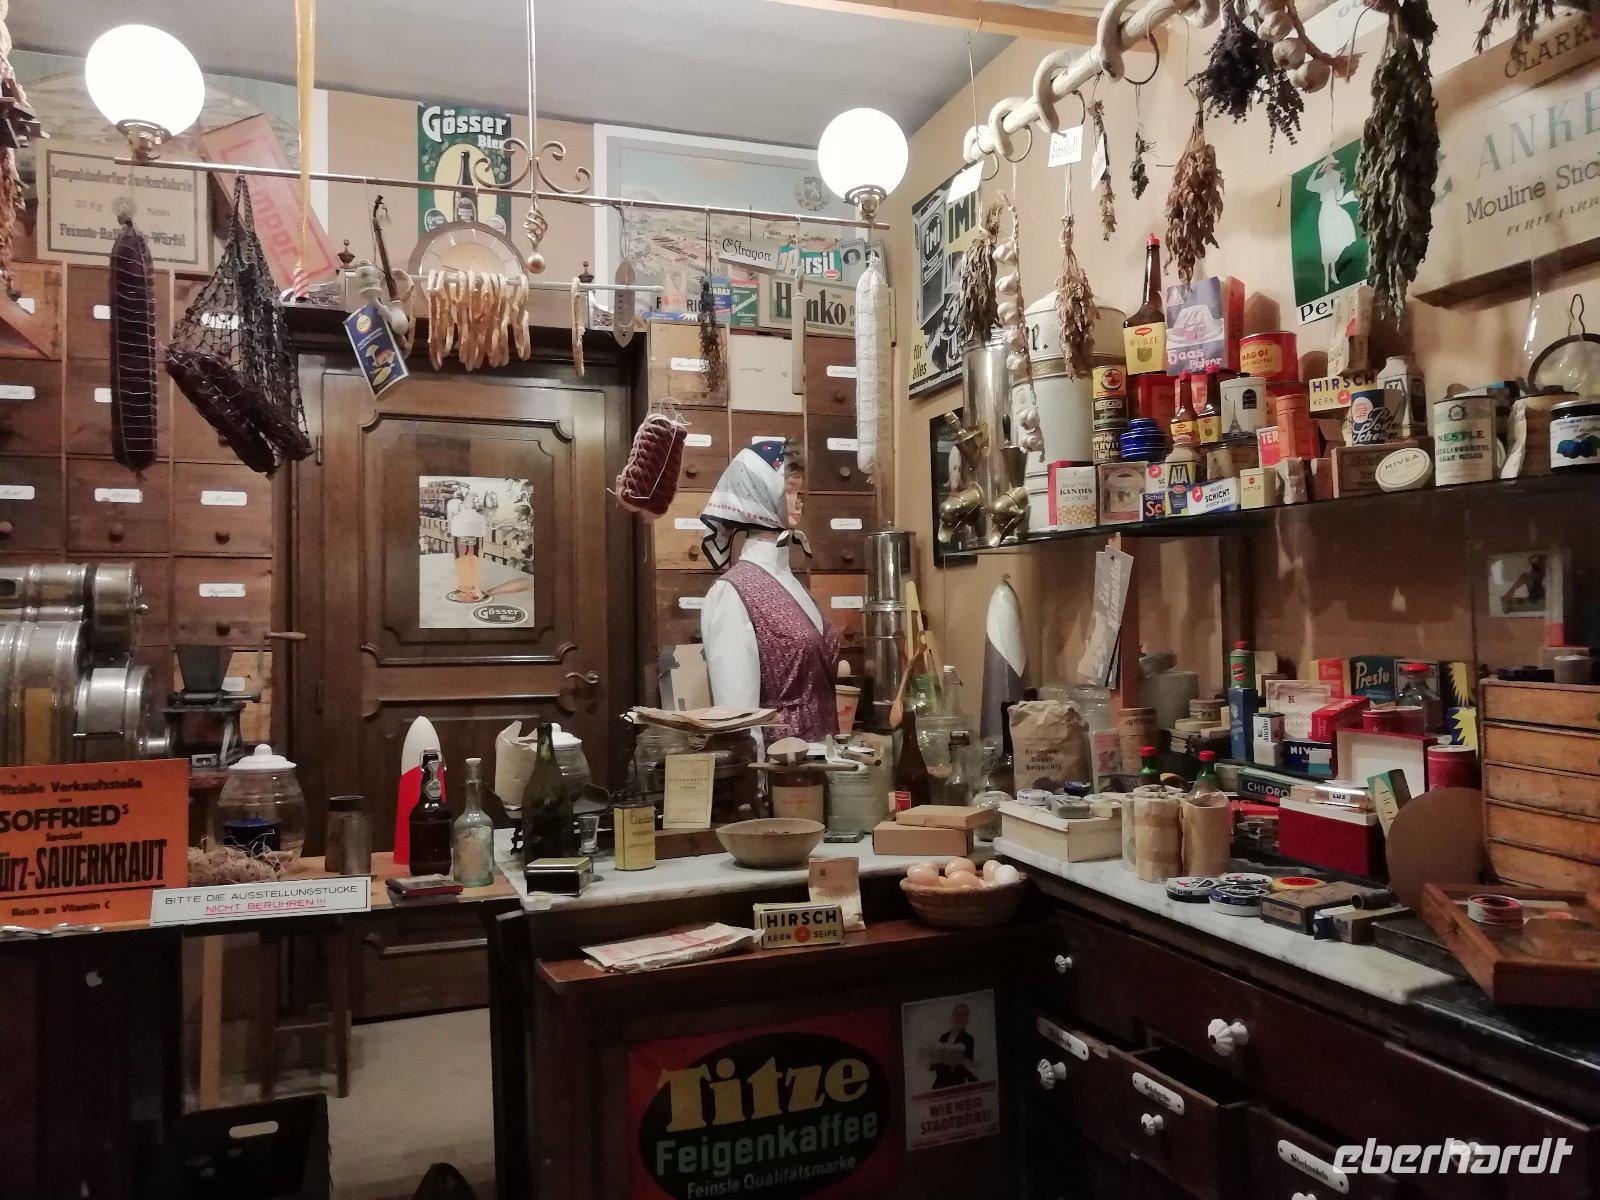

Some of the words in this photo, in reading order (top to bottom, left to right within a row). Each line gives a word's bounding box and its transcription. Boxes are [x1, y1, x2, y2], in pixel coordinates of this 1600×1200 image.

[421, 106, 508, 142] Gösser
[1465, 176, 1546, 224] Mouliné
[775, 281, 847, 326] Hnko
[1312, 372, 1375, 394] HIRSCH
[1385, 454, 1419, 470] NIVEA
[1170, 465, 1189, 484] ATA
[1204, 488, 1231, 502] SCHICHT
[1355, 661, 1391, 689] Presto
[62, 902, 101, 913] Vitamin
[104, 900, 111, 910] C
[165, 895, 202, 905] BITTE
[206, 893, 226, 902] DIE
[205, 903, 240, 914] NICHT
[766, 909, 838, 928] HIRSCH
[767, 931, 792, 942] KERN
[813, 929, 838, 939] SEIFE
[656, 1056, 870, 1132] Titze
[929, 1096, 984, 1119] WIENER
[656, 1111, 879, 1178] Feigenkaffee
[687, 1178, 740, 1200] Feinste
